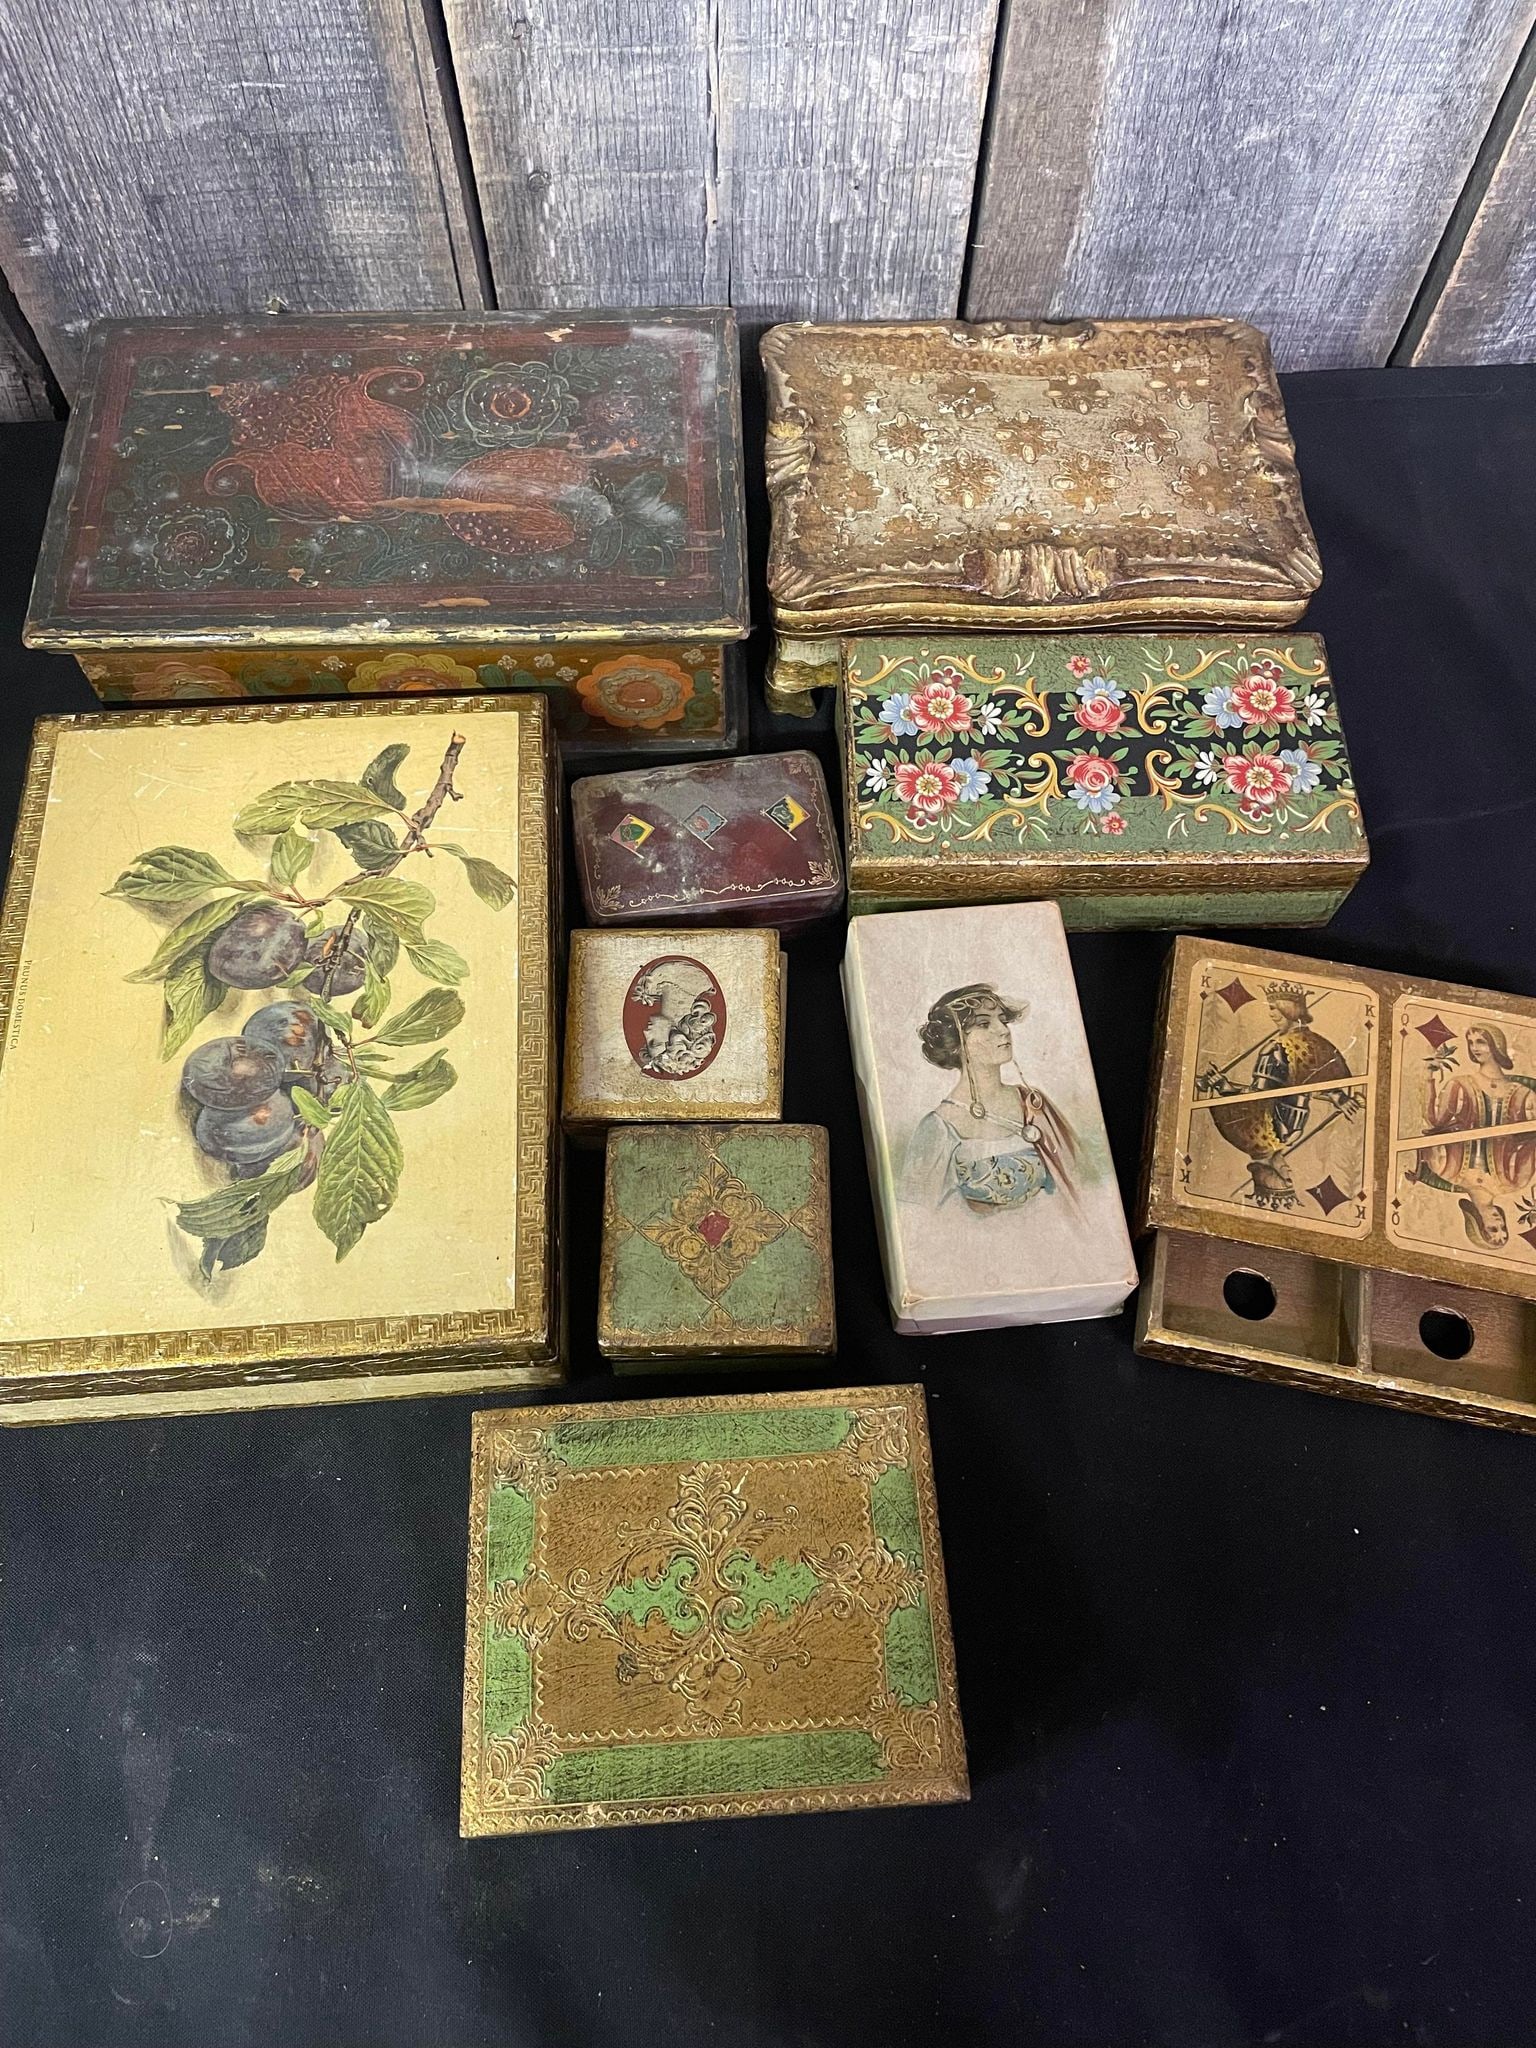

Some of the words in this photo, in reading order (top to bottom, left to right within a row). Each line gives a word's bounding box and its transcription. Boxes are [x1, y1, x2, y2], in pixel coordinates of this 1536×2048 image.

[19, 960, 32, 996] PRUNUS
[1200, 976, 1211, 988] K
[1365, 1004, 1376, 1017] K
[10, 998, 26, 1050] DOMESTICA
[1400, 1013, 1410, 1027] Q
[1179, 1169, 1191, 1183] K
[1355, 1205, 1366, 1219] K
[1391, 1211, 1400, 1225] Q
